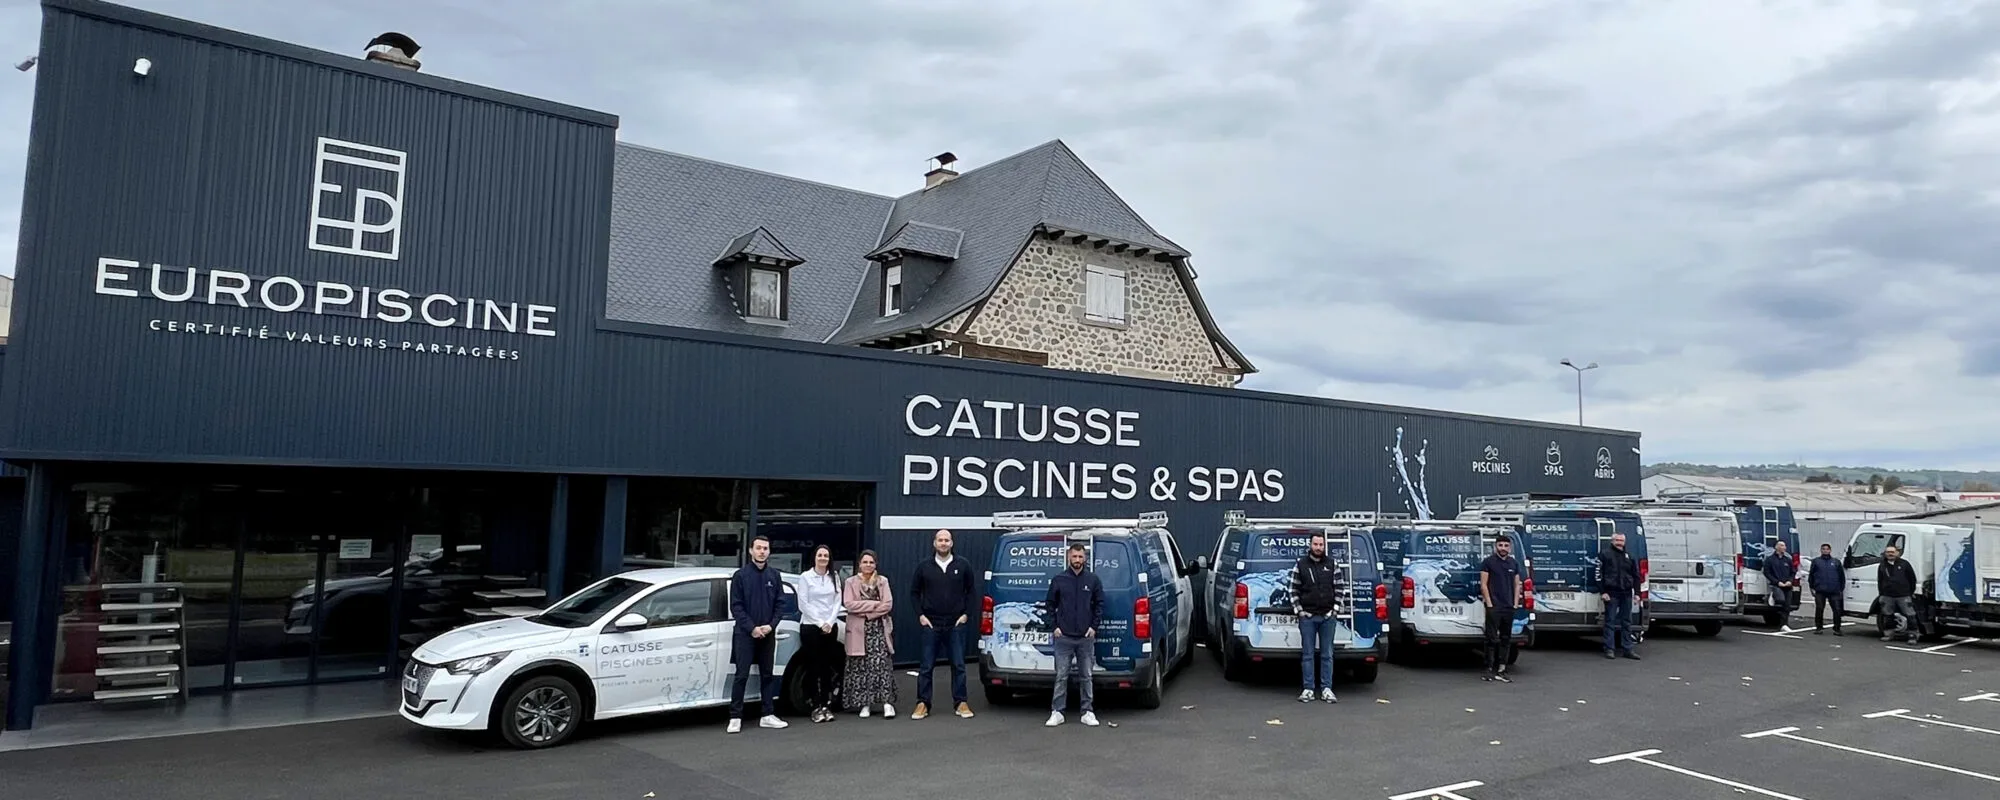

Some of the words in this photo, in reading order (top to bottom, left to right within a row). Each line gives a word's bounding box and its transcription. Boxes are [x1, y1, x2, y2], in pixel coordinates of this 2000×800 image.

[95, 257, 557, 336] EUROPISCINE
[149, 317, 269, 340] CERTIFIÉ
[286, 330, 389, 350] VALEURS
[402, 341, 520, 362] PARTAGÉES
[904, 394, 1141, 447] CATUSSE
[1472, 461, 1511, 474] PISCINES
[1544, 465, 1564, 476] SPAS
[902, 454, 1138, 501] PISCINES
[1149, 467, 1177, 501] &
[1187, 467, 1285, 502] SPAS
[1594, 468, 1615, 479] ABRIS
[1716, 506, 1748, 514] TUSSE
[1531, 524, 1568, 532] CATUSSE
[1261, 538, 1310, 547] CATUSSE
[1425, 536, 1470, 544] CATUSSE
[1010, 547, 1064, 556] CATUSSE
[1426, 544, 1471, 552] PISCINES
[1009, 558, 1064, 568] PISCINES
[601, 642, 663, 654] CATUSSE
[600, 656, 662, 670] PISCINES
[665, 655, 673, 664] &
[676, 652, 710, 663] SPAS
